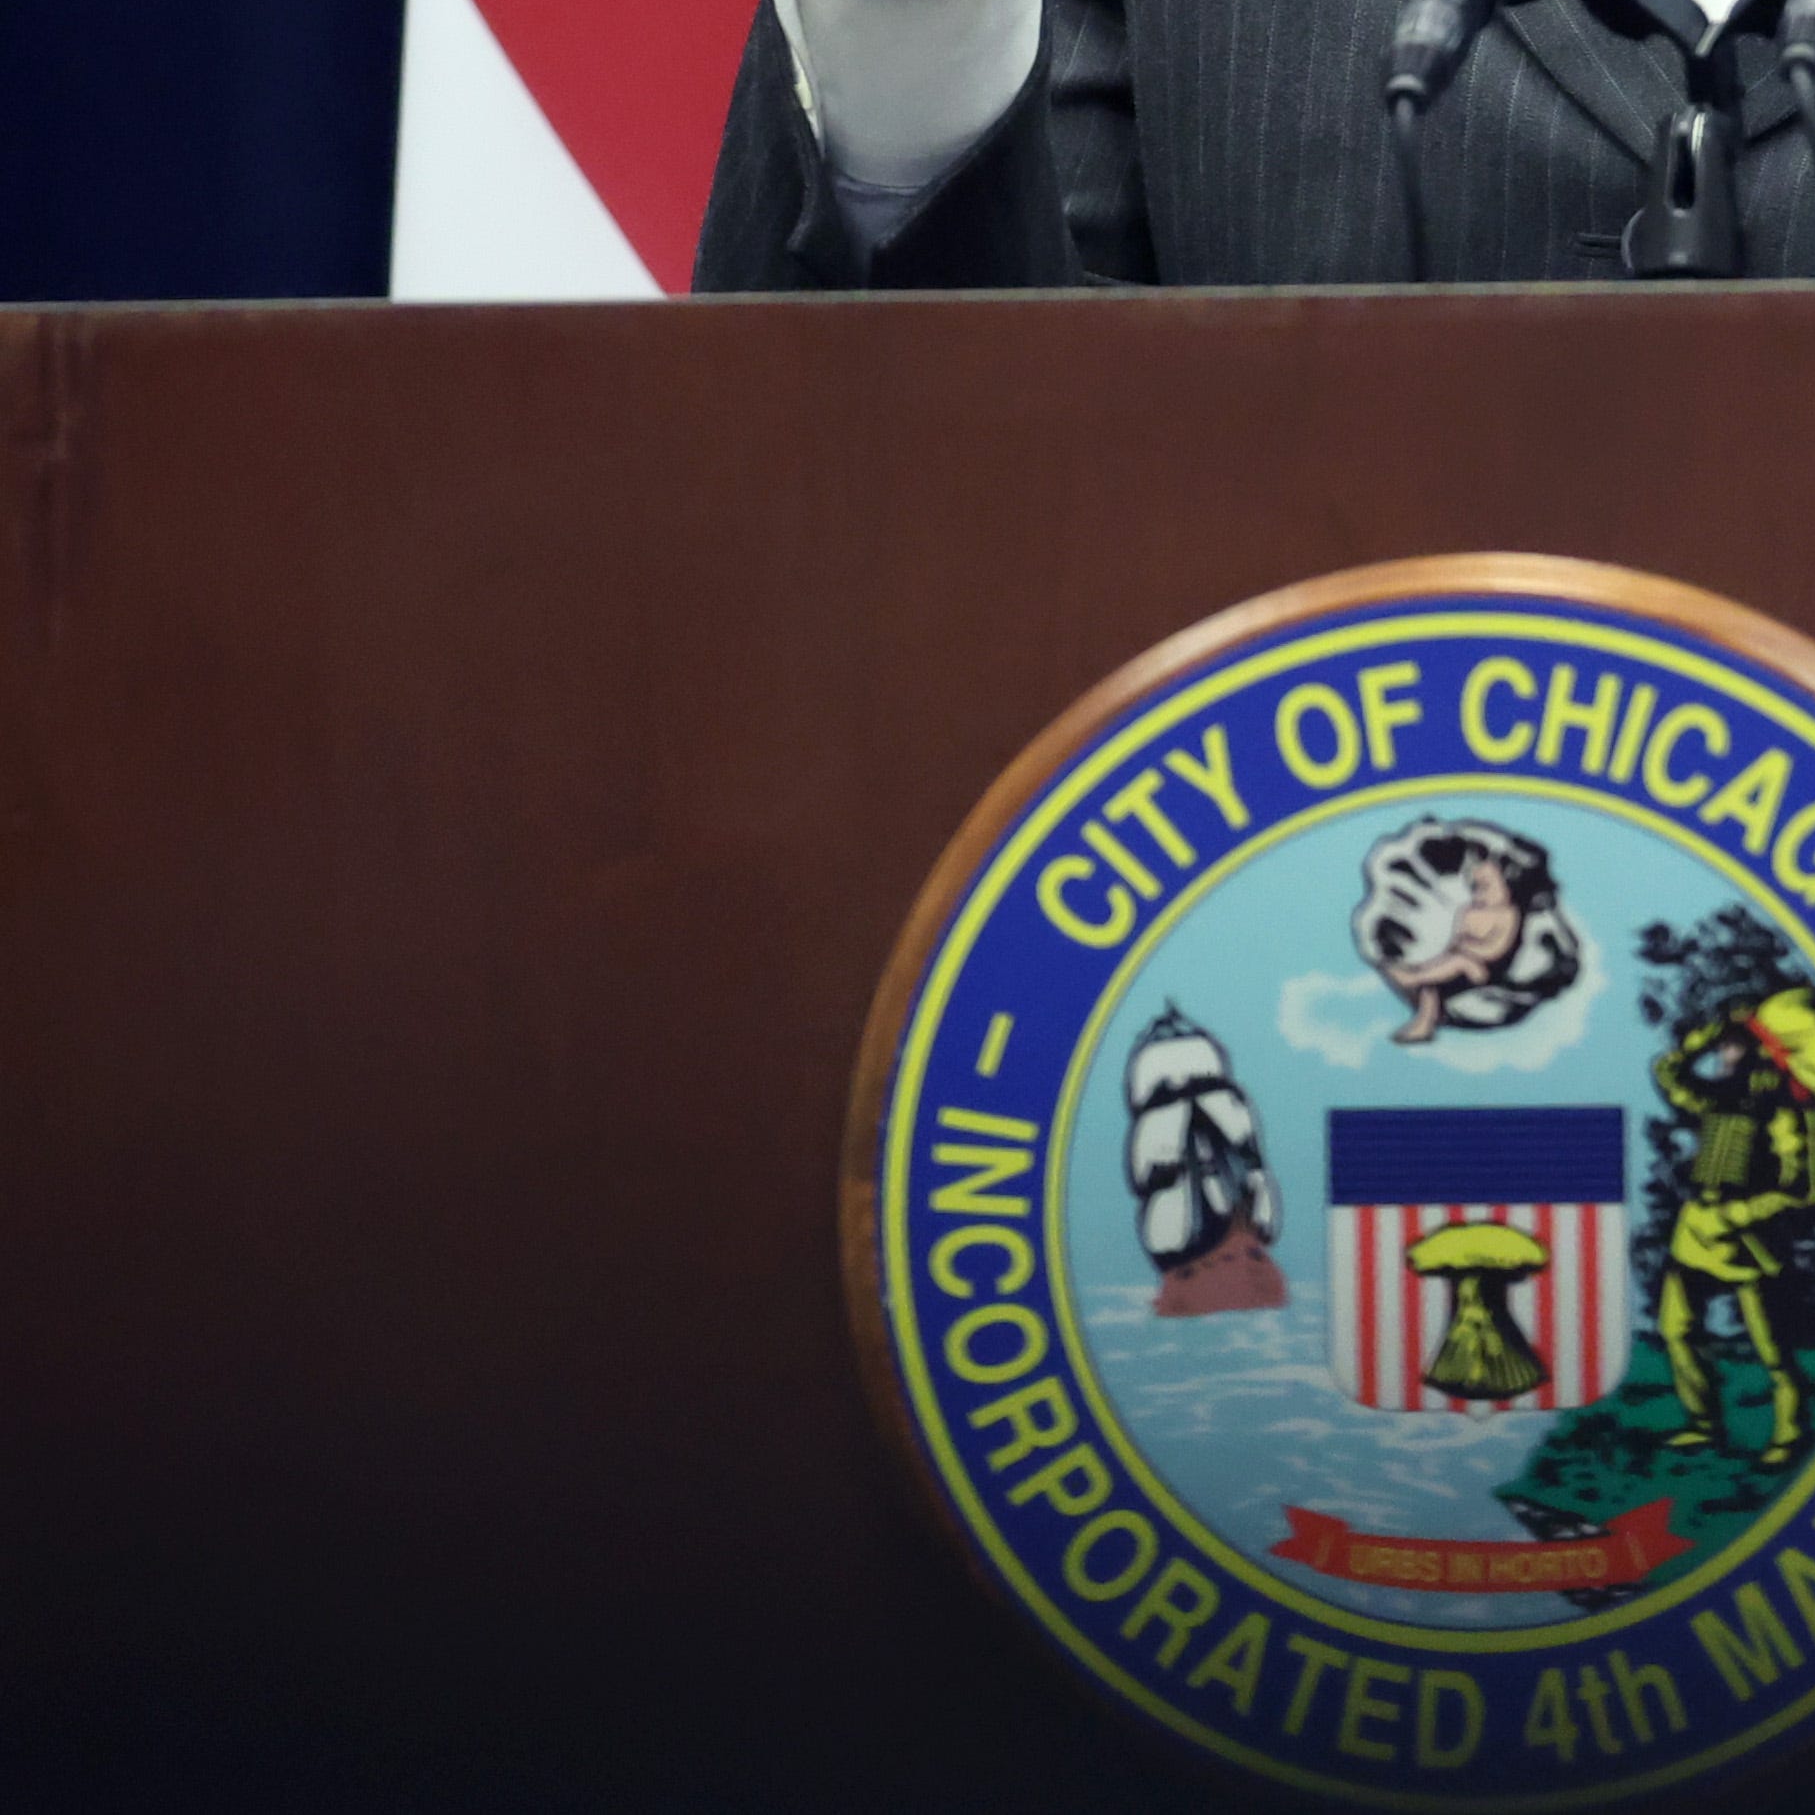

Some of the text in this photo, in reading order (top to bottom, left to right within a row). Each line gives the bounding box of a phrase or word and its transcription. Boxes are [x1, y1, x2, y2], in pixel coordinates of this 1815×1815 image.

[1036, 726, 1249, 948] CITY
[1275, 661, 1421, 788] OF
[929, 1106, 1486, 1769] INCORPORATED
[1524, 1650, 1687, 1764] 4th
